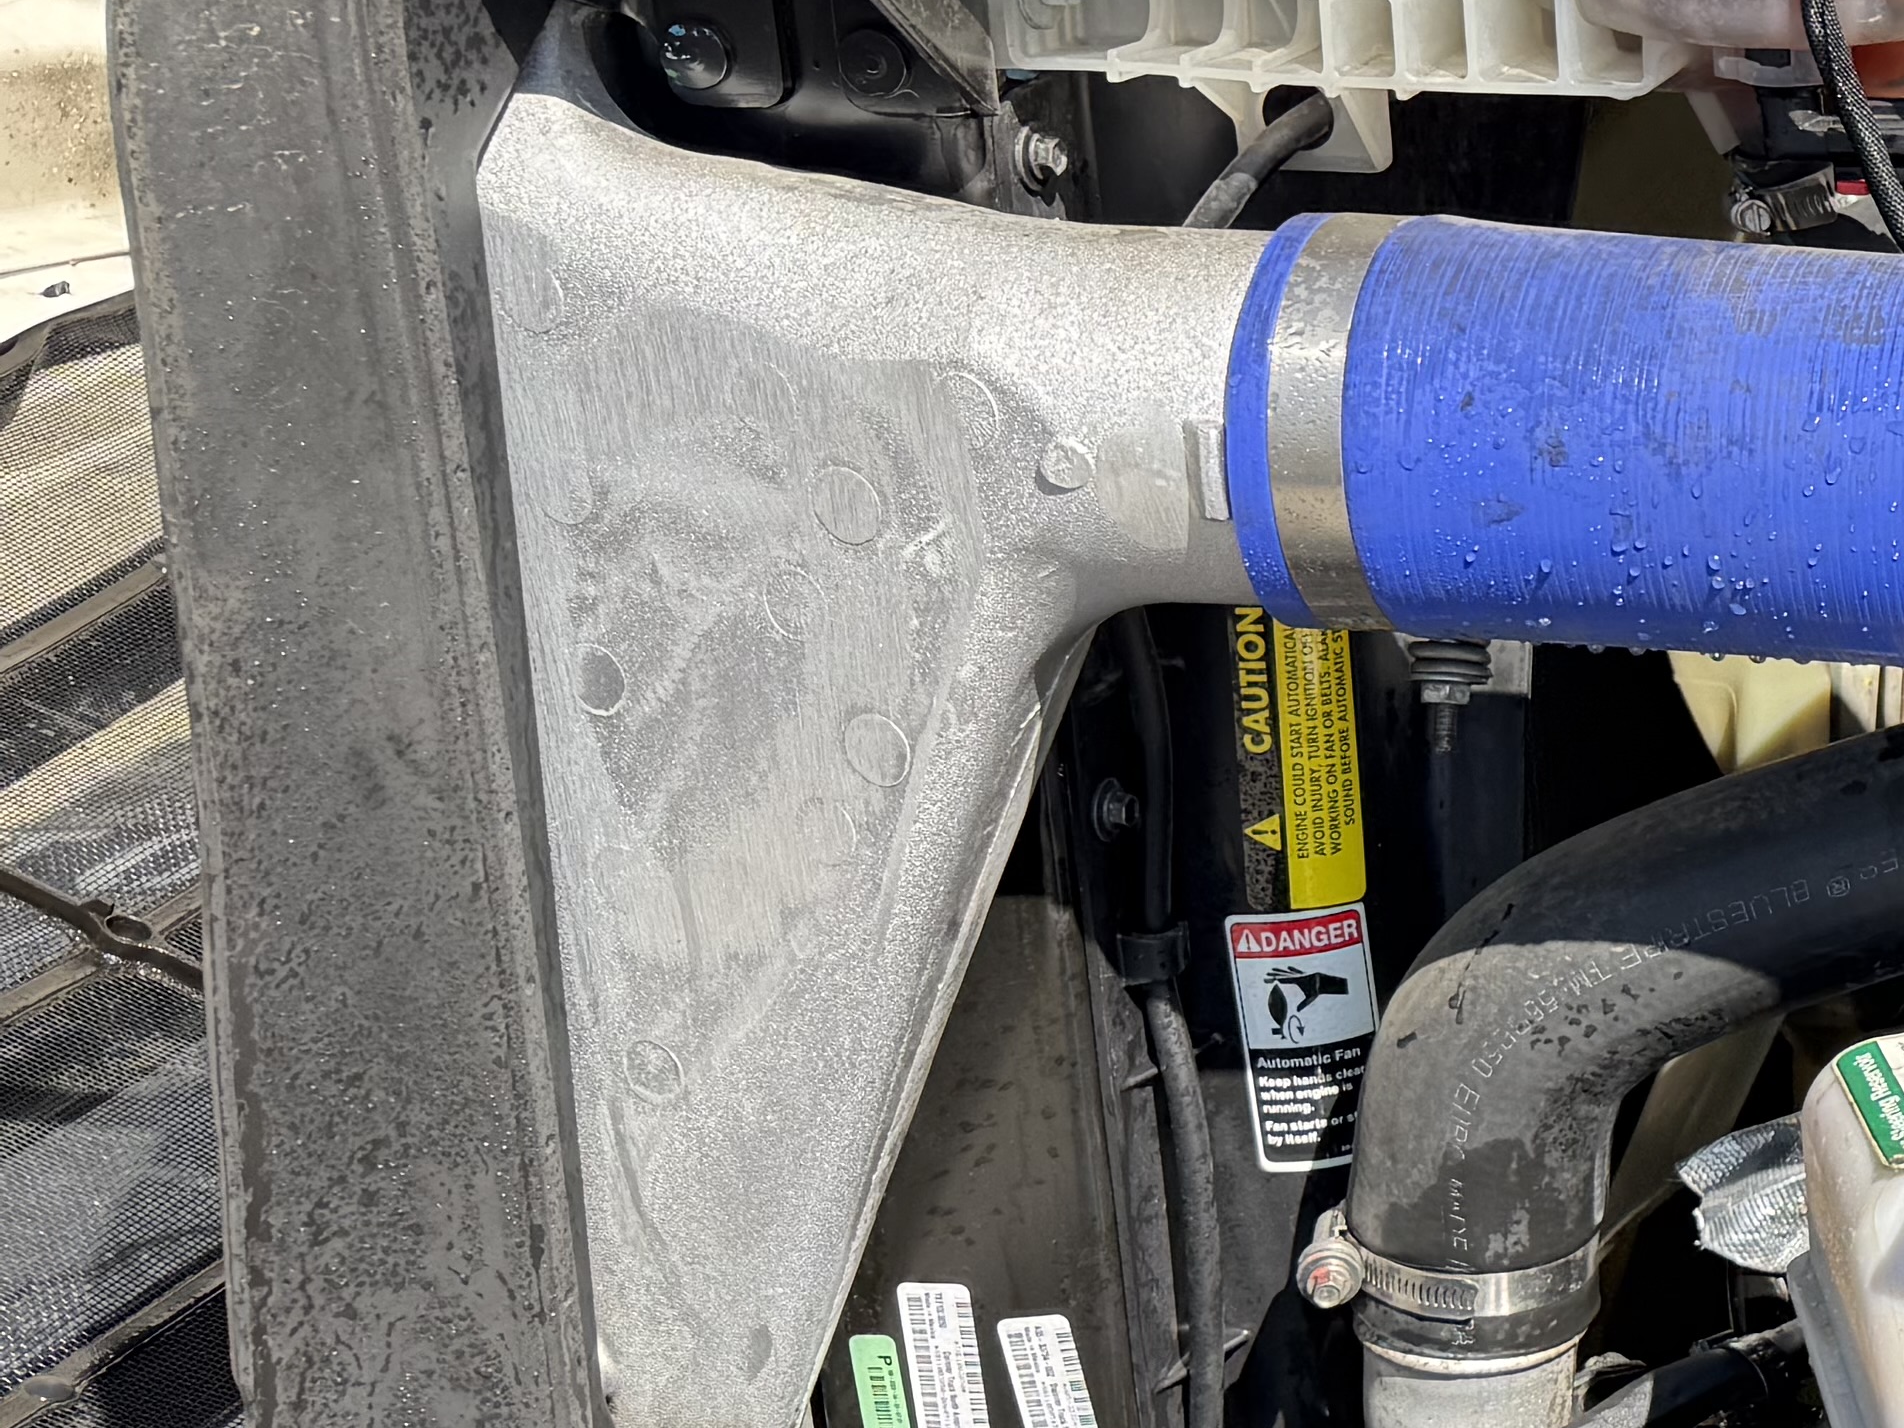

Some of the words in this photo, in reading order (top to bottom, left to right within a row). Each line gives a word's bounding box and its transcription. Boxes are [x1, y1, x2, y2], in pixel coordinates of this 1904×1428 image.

[1235, 607, 1272, 754] CAUTION
[1305, 664, 1319, 723] IGNITION
[1320, 667, 1332, 706] BELTS.
[1334, 648, 1351, 723] AUTOMATIC
[1322, 710, 1334, 729] OR
[1290, 722, 1304, 758] START
[1308, 727, 1321, 761] TURN
[1324, 732, 1336, 760] FAN
[1339, 727, 1355, 778] BEFORE
[1293, 762, 1308, 807] COULD
[1310, 764, 1325, 812] INJURY,
[1325, 763, 1338, 791] ON
[1342, 783, 1356, 824] SOUND
[1296, 813, 1310, 859] ENGINE
[1311, 816, 1326, 856] AVOID
[1328, 796, 1342, 855] WORKING
[1260, 920, 1358, 952] DANGER
[1621, 878, 1810, 970] BLUESTRIPE
[1257, 1052, 1331, 1069] Automatic
[1334, 1046, 1361, 1061] Fan
[1259, 1076, 1291, 1089] Keep
[1293, 1072, 1332, 1086] hands
[1261, 1088, 1294, 1100] when
[1296, 1085, 1339, 1100] engine
[1343, 1083, 1353, 1091] is
[1854, 1052, 1890, 1102] Reservoir
[1263, 1102, 1315, 1115] running.
[1266, 1120, 1288, 1132] Fan
[1290, 1118, 1327, 1131] starts
[1331, 1116, 1343, 1125] or
[1267, 1134, 1283, 1147] by
[1285, 1132, 1321, 1145] itself.
[877, 1355, 892, 1367] P
